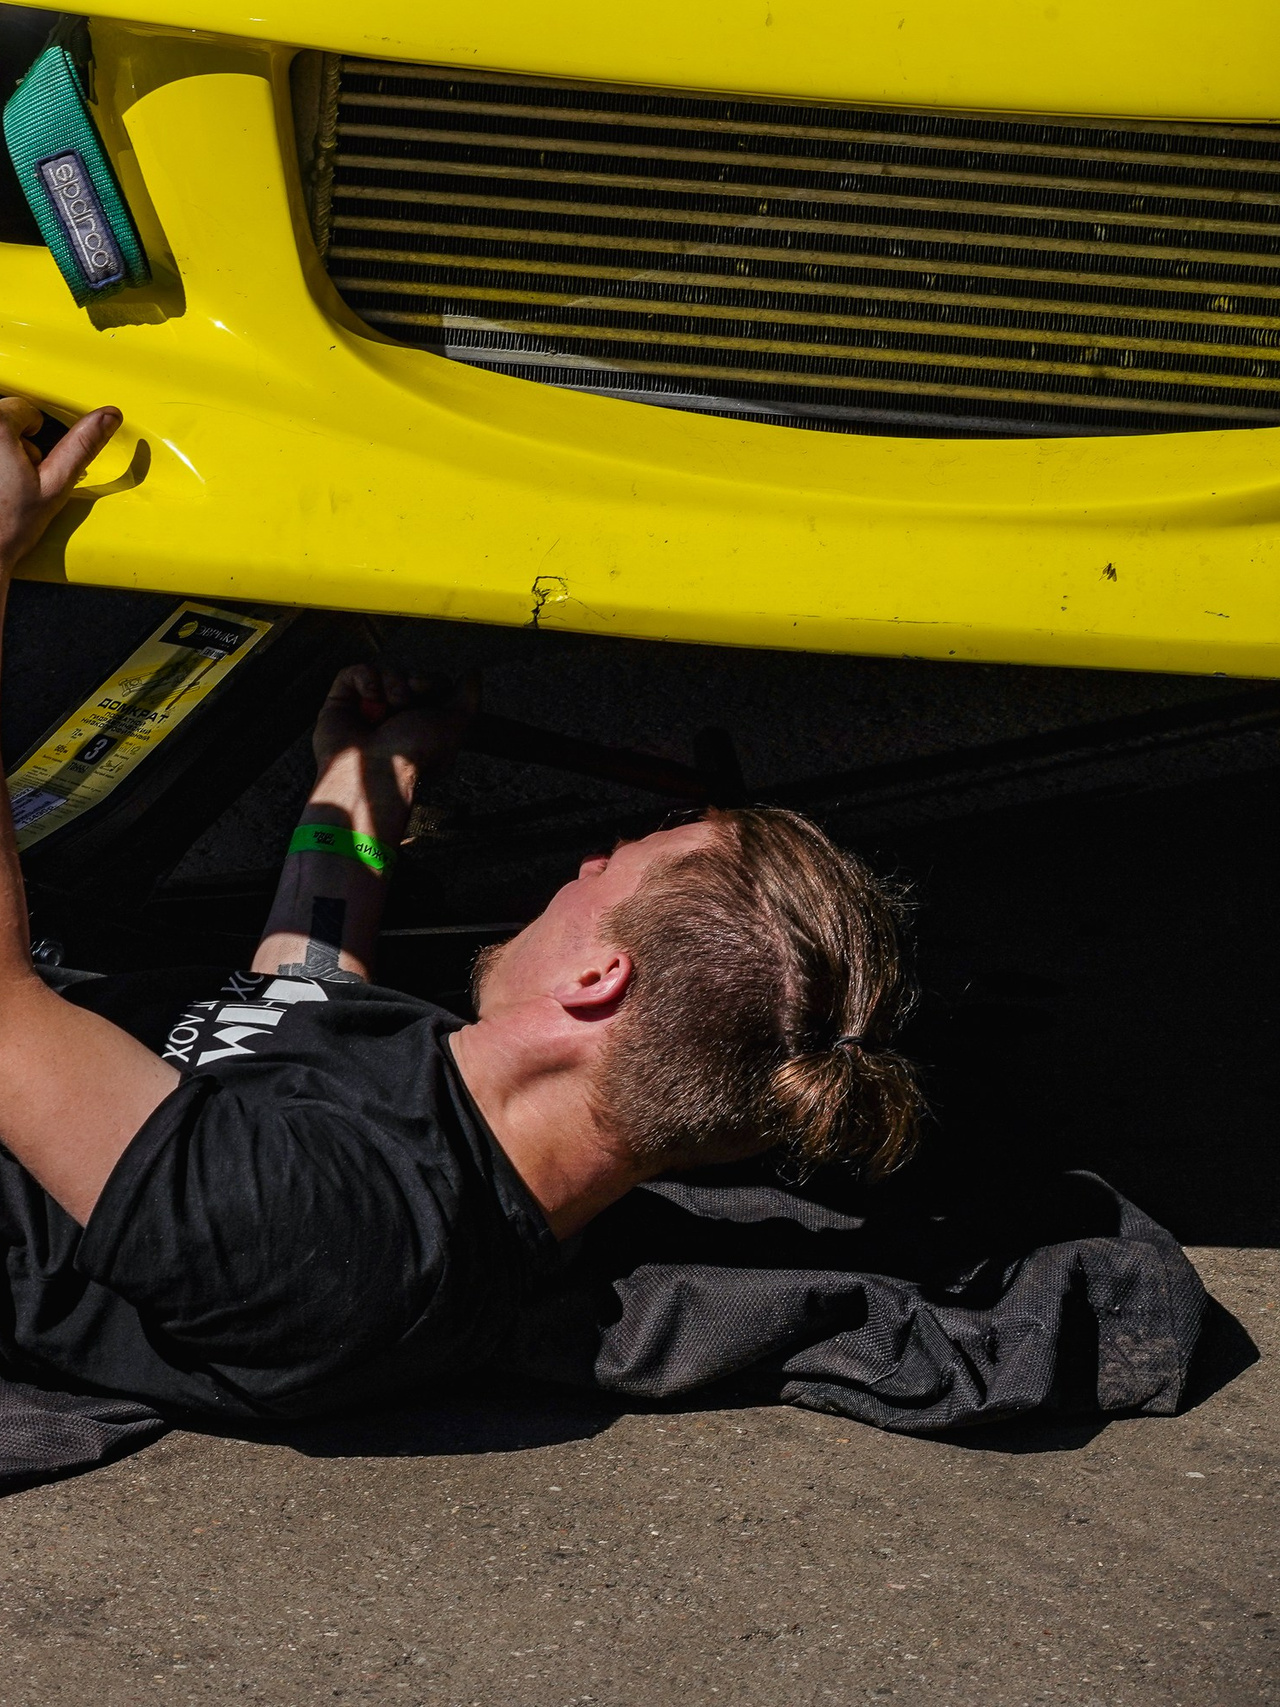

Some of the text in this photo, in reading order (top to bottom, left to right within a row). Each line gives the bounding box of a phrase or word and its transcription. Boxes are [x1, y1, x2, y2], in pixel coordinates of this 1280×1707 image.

[49, 163, 110, 273] sparco
[97, 697, 169, 724] ДОМКРАТ
[84, 738, 108, 760] 3
[355, 842, 388, 863] ЖИР
